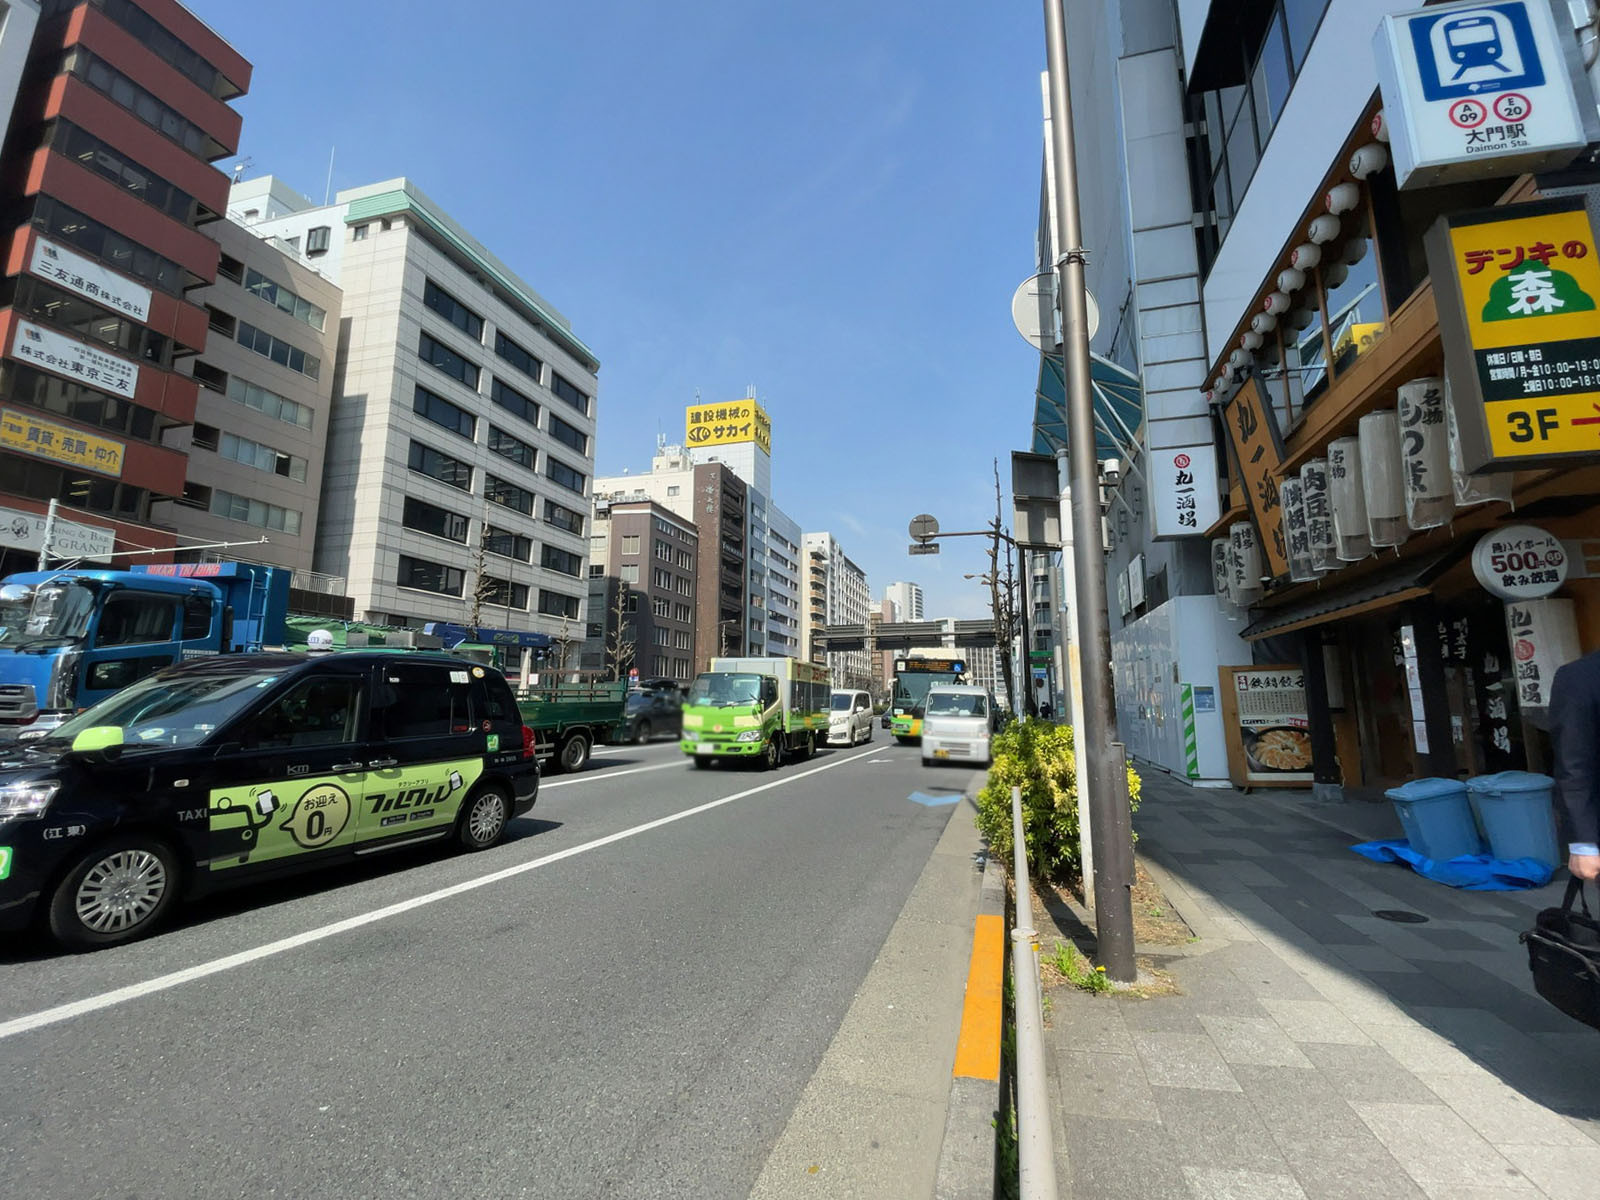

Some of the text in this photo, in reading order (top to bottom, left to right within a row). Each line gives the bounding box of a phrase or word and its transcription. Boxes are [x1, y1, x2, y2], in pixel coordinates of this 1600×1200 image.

[1462, 104, 1472, 112] A
[1504, 106, 1522, 116] 20
[1507, 98, 1514, 106] E
[1459, 112, 1478, 123] 09
[1465, 123, 1527, 145] 大門駅
[1466, 139, 1531, 154] Daimon Sta.
[1464, 240, 1587, 275] デンキの
[38, 260, 144, 317] 三友通商株式会社
[1507, 270, 1565, 315] 森
[20, 344, 130, 392] 株式会社東京三友
[690, 407, 750, 424] 建設機械の
[1421, 388, 1444, 426] 名物
[713, 422, 752, 439] サカイ
[1507, 409, 1559, 443] 3F
[1330, 449, 1346, 479] 名物
[1175, 469, 1197, 528] 丸一酒場
[35, 520, 76, 537] DNING
[78, 530, 85, 538] &
[1502, 569, 1559, 587] 飲み放題
[304, 792, 338, 811] お迎え
[177, 807, 208, 822] TAXI
